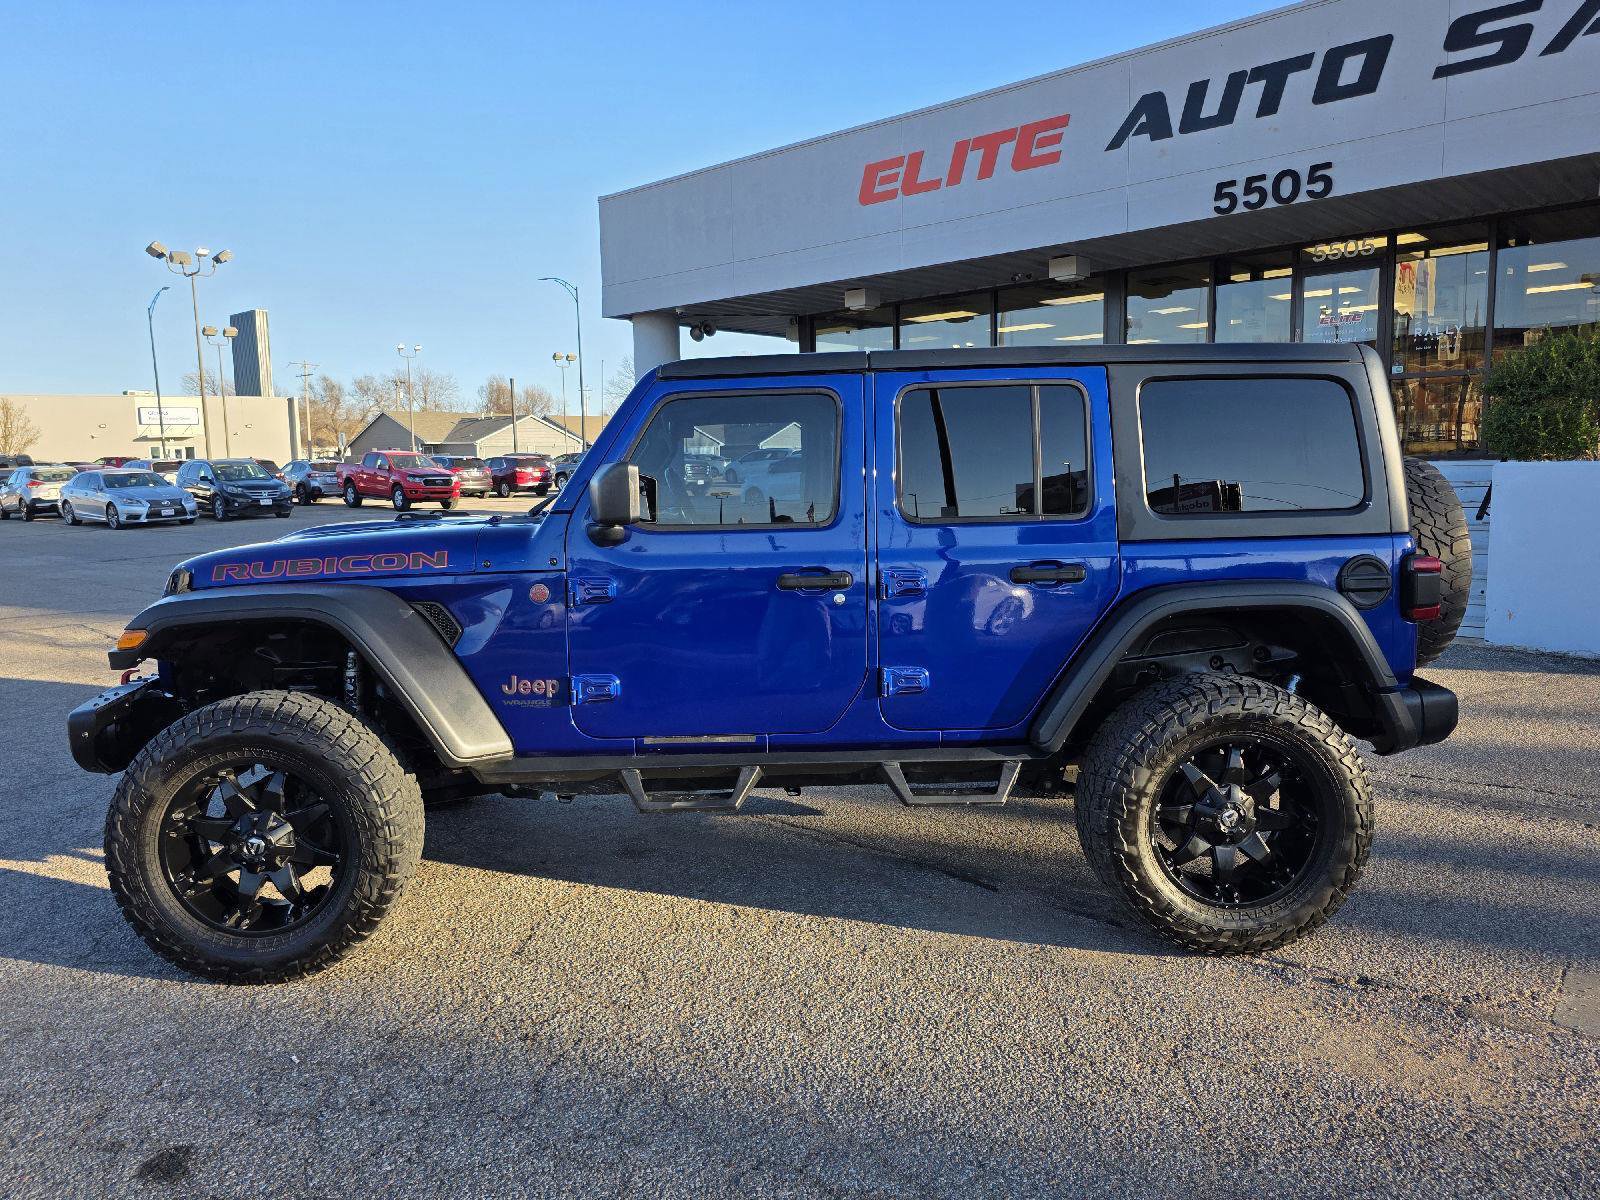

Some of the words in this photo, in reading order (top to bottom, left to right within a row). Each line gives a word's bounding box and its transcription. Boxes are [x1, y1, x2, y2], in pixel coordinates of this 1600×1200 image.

[858, 113, 1070, 206] ELITE
[1104, 33, 1393, 151] AUTO
[1213, 162, 1333, 215] 5505
[1312, 237, 1376, 262] 5505
[1319, 311, 1365, 326] ELITE
[1414, 324, 1463, 337] RALLY
[212, 550, 448, 581] RUBICON
[502, 675, 560, 697] Jeep
